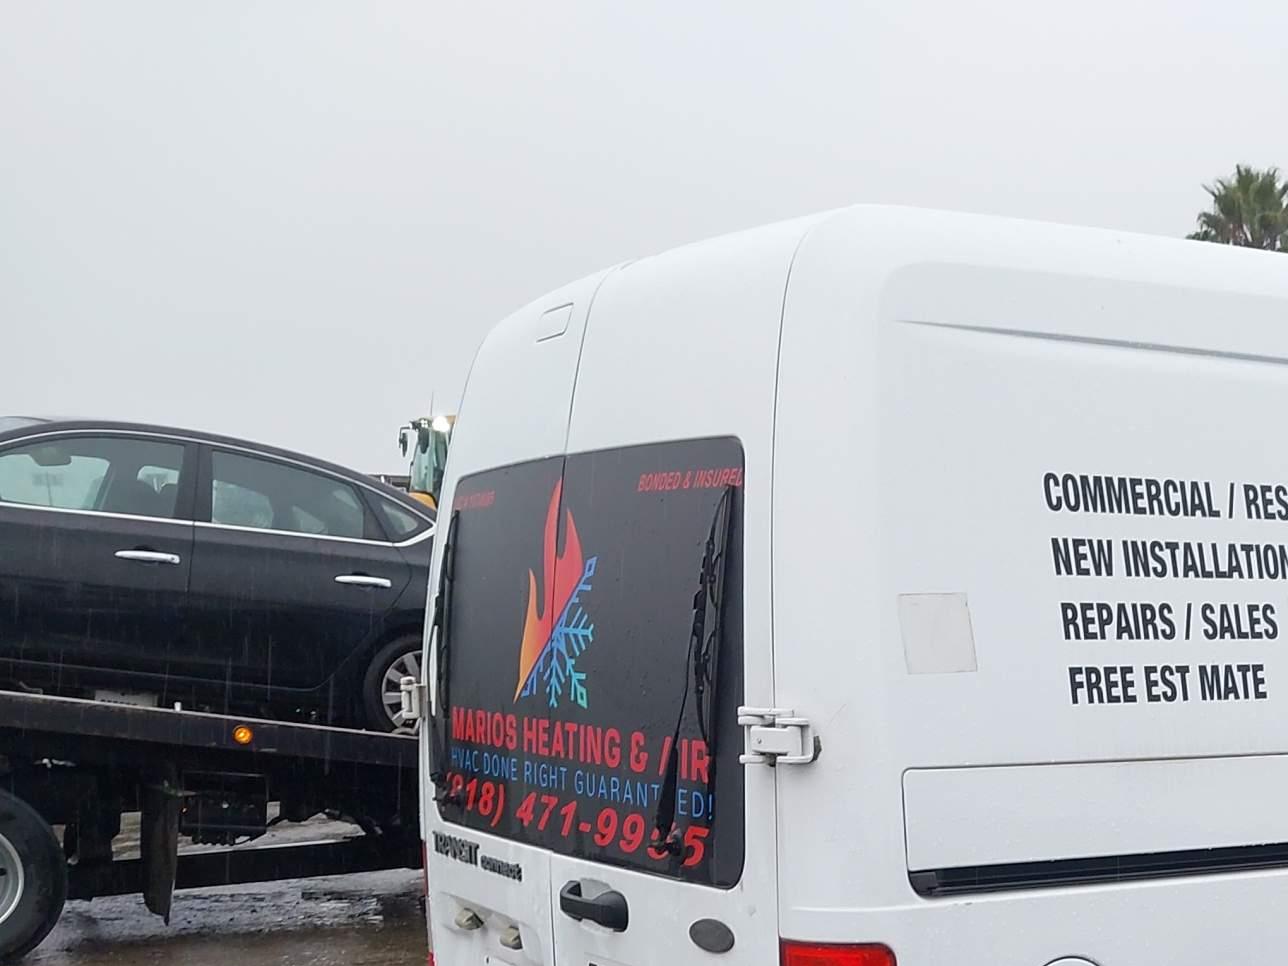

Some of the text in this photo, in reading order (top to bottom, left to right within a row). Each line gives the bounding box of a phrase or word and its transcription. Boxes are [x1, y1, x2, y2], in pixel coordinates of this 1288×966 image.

[638, 473, 680, 491] BONDED
[683, 471, 691, 488] &
[1043, 472, 1221, 518] COMMERCIAL
[1228, 482, 1235, 519] /
[1050, 537, 1114, 577] NEW
[1060, 602, 1278, 641] REPAIRS / SALES
[1068, 666, 1138, 705] FREE
[452, 706, 517, 750] MARIOS
[523, 717, 621, 768] HEATING
[630, 731, 648, 773] &
[451, 746, 713, 820] HVAC DONE RIGHT GUARANTED!
